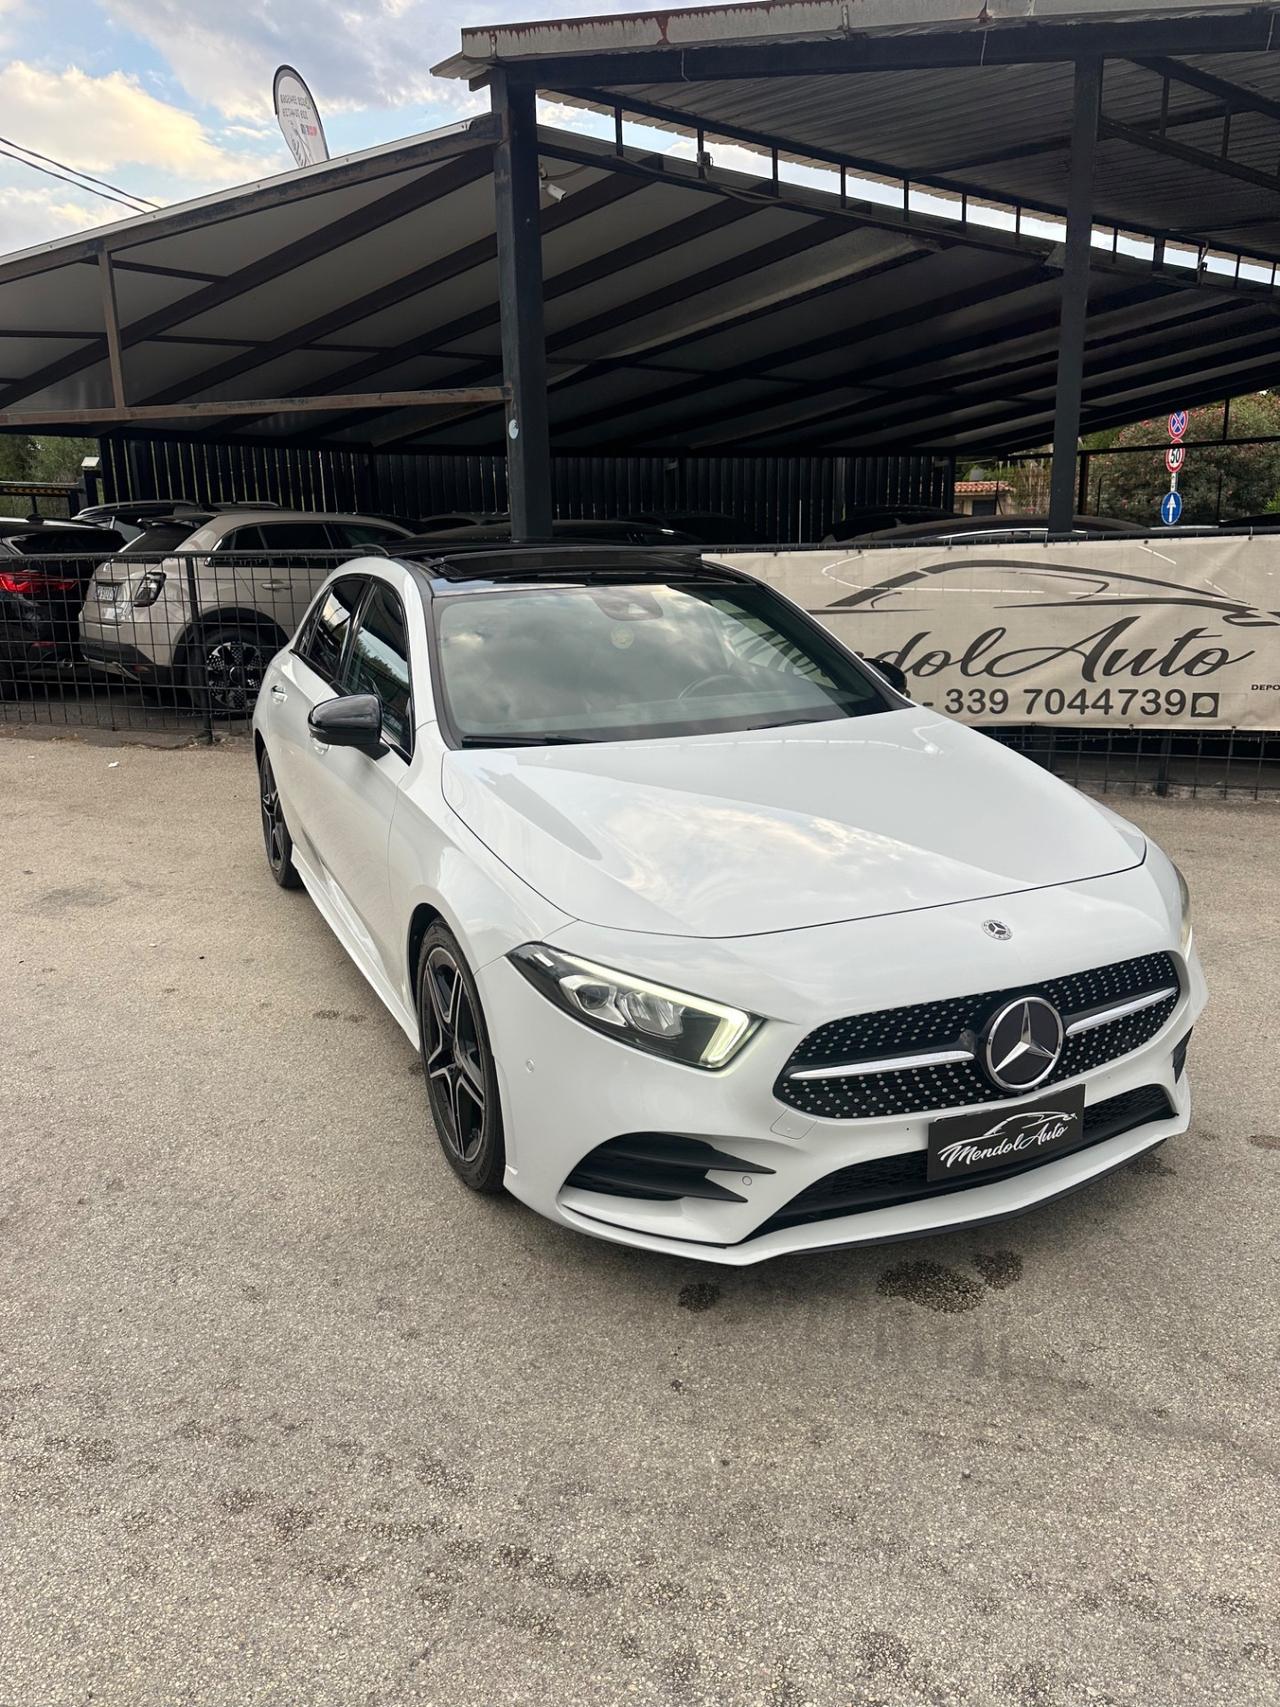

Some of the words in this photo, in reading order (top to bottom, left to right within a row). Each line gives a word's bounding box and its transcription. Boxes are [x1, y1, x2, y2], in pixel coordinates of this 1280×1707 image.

[1170, 448, 1180, 463] 50
[944, 688, 1010, 715] 339
[1023, 688, 1187, 716] 7044739
[937, 1121, 1068, 1168] MendolAuto
